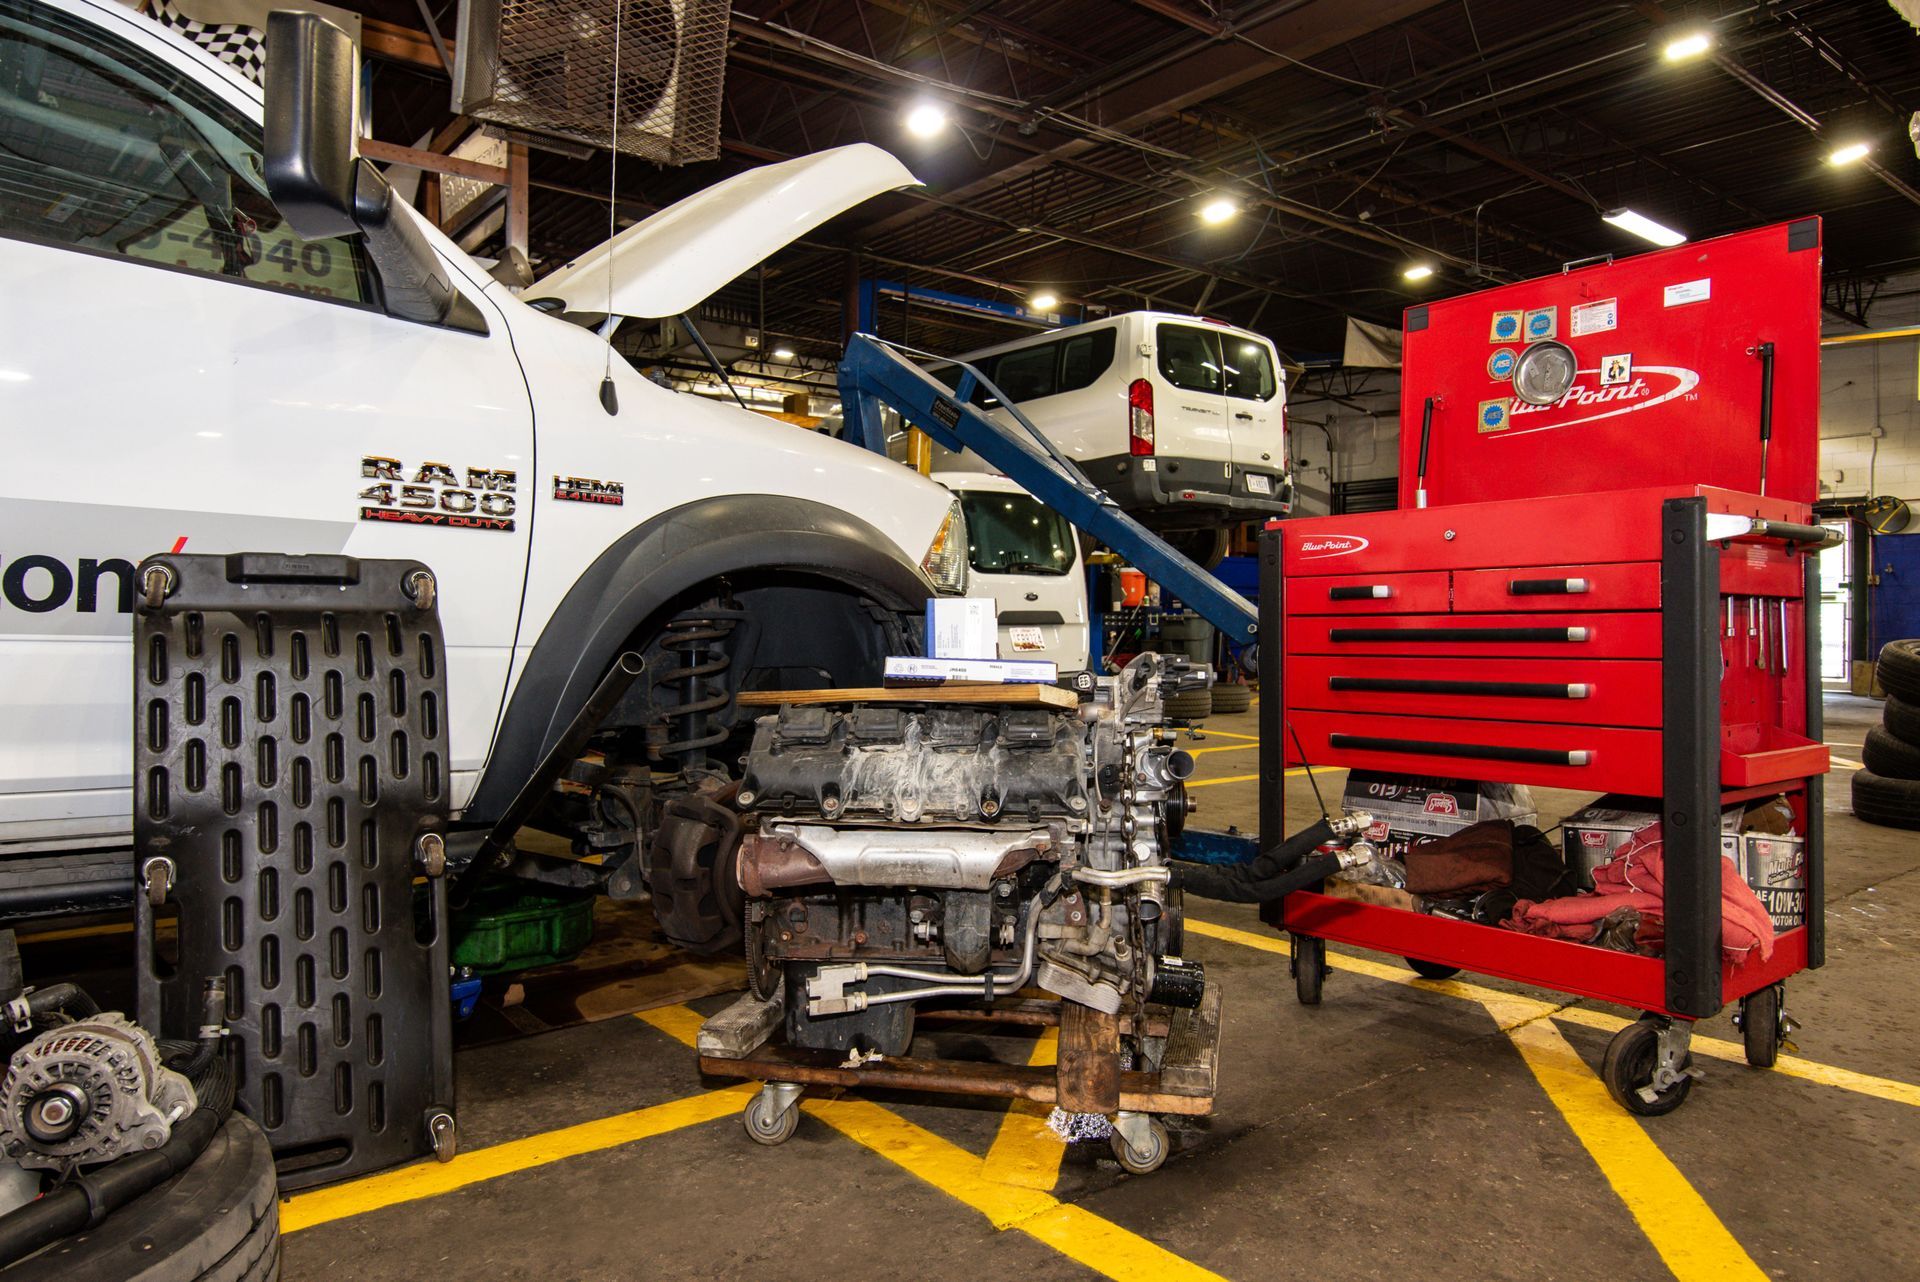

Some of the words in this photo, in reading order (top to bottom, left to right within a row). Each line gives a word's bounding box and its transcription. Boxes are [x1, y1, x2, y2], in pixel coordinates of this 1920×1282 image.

[361, 455, 516, 492] RAM
[553, 475, 624, 494] HEMI
[358, 482, 516, 516] 4500
[555, 490, 579, 500] 6.4
[582, 493, 622, 504] LITER
[365, 508, 445, 524] HEAVY
[449, 517, 513, 529] DUTY
[0, 554, 136, 613] on
[1768, 890, 1805, 913] 10W-30
